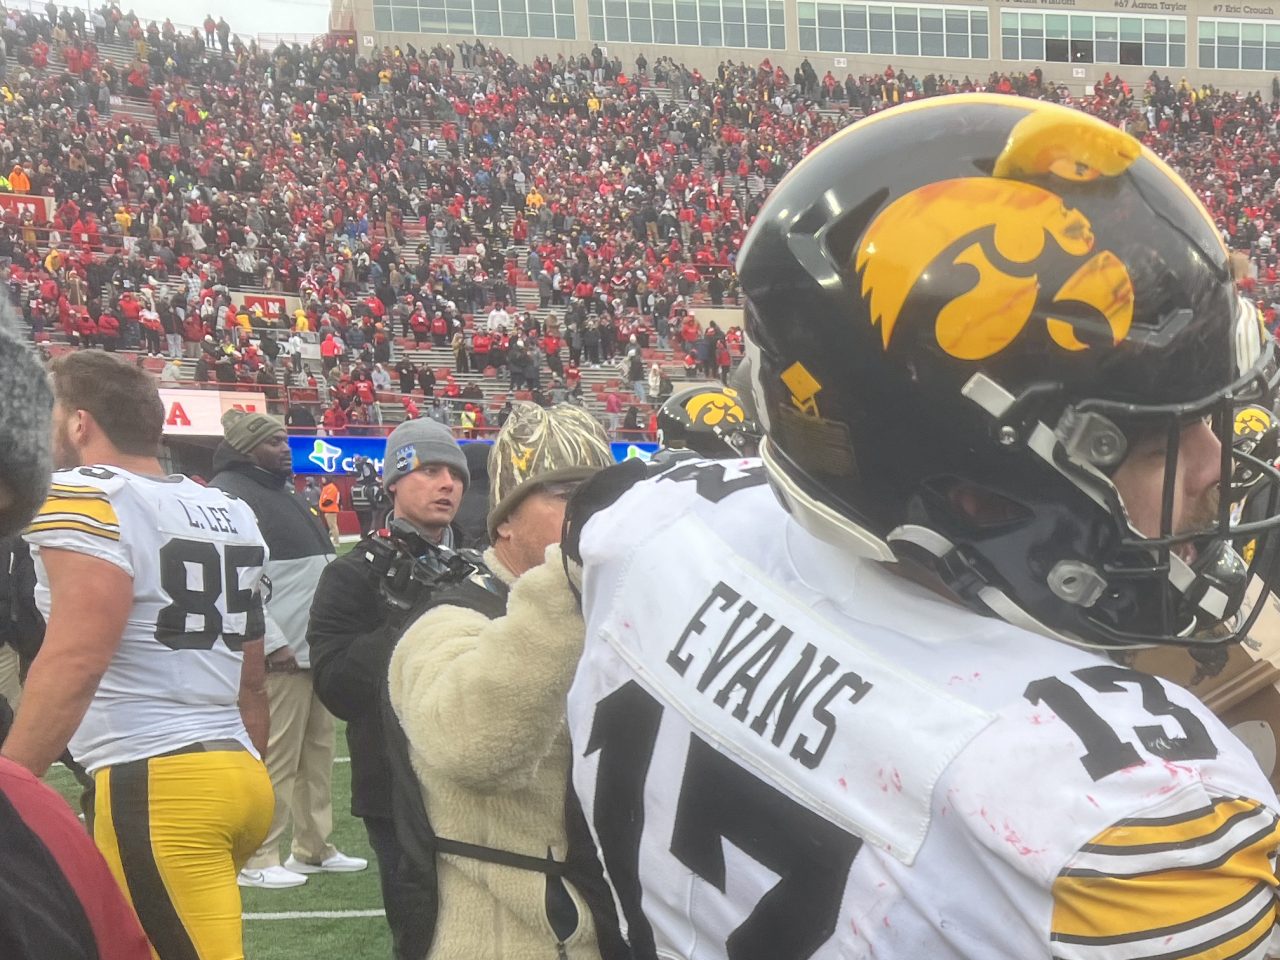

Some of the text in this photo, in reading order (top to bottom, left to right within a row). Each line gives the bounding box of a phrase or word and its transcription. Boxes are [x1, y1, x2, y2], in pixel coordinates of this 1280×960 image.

[1131, 0, 1158, 10] Aaron
[1160, 2, 1186, 11] Taylor
[1225, 6, 1241, 14] Eric
[1243, 7, 1273, 15] Crouch
[154, 537, 266, 652] 85
[666, 581, 873, 770] EVANS
[1023, 665, 1217, 782] 13
